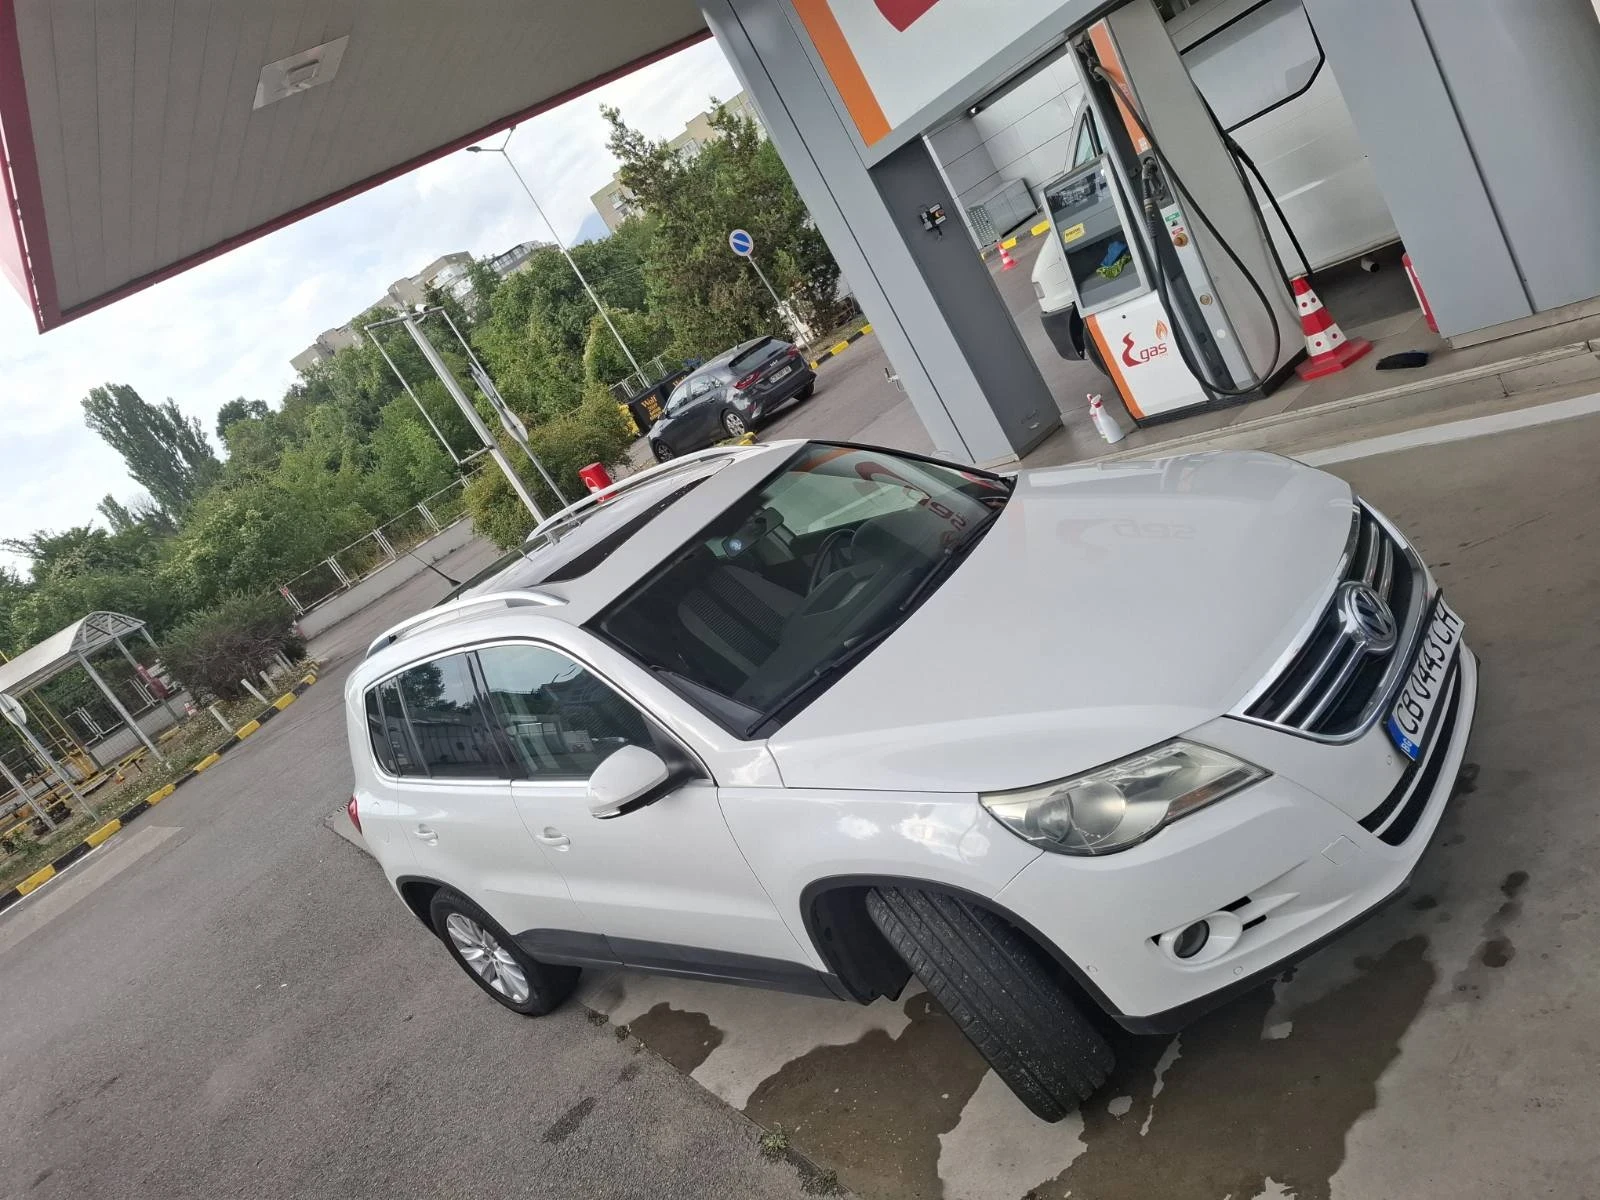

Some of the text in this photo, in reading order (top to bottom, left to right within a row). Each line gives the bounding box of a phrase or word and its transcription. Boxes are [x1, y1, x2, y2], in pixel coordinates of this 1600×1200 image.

[1396, 600, 1460, 736] CB 0443 CH
[1400, 737, 1414, 754] BG
